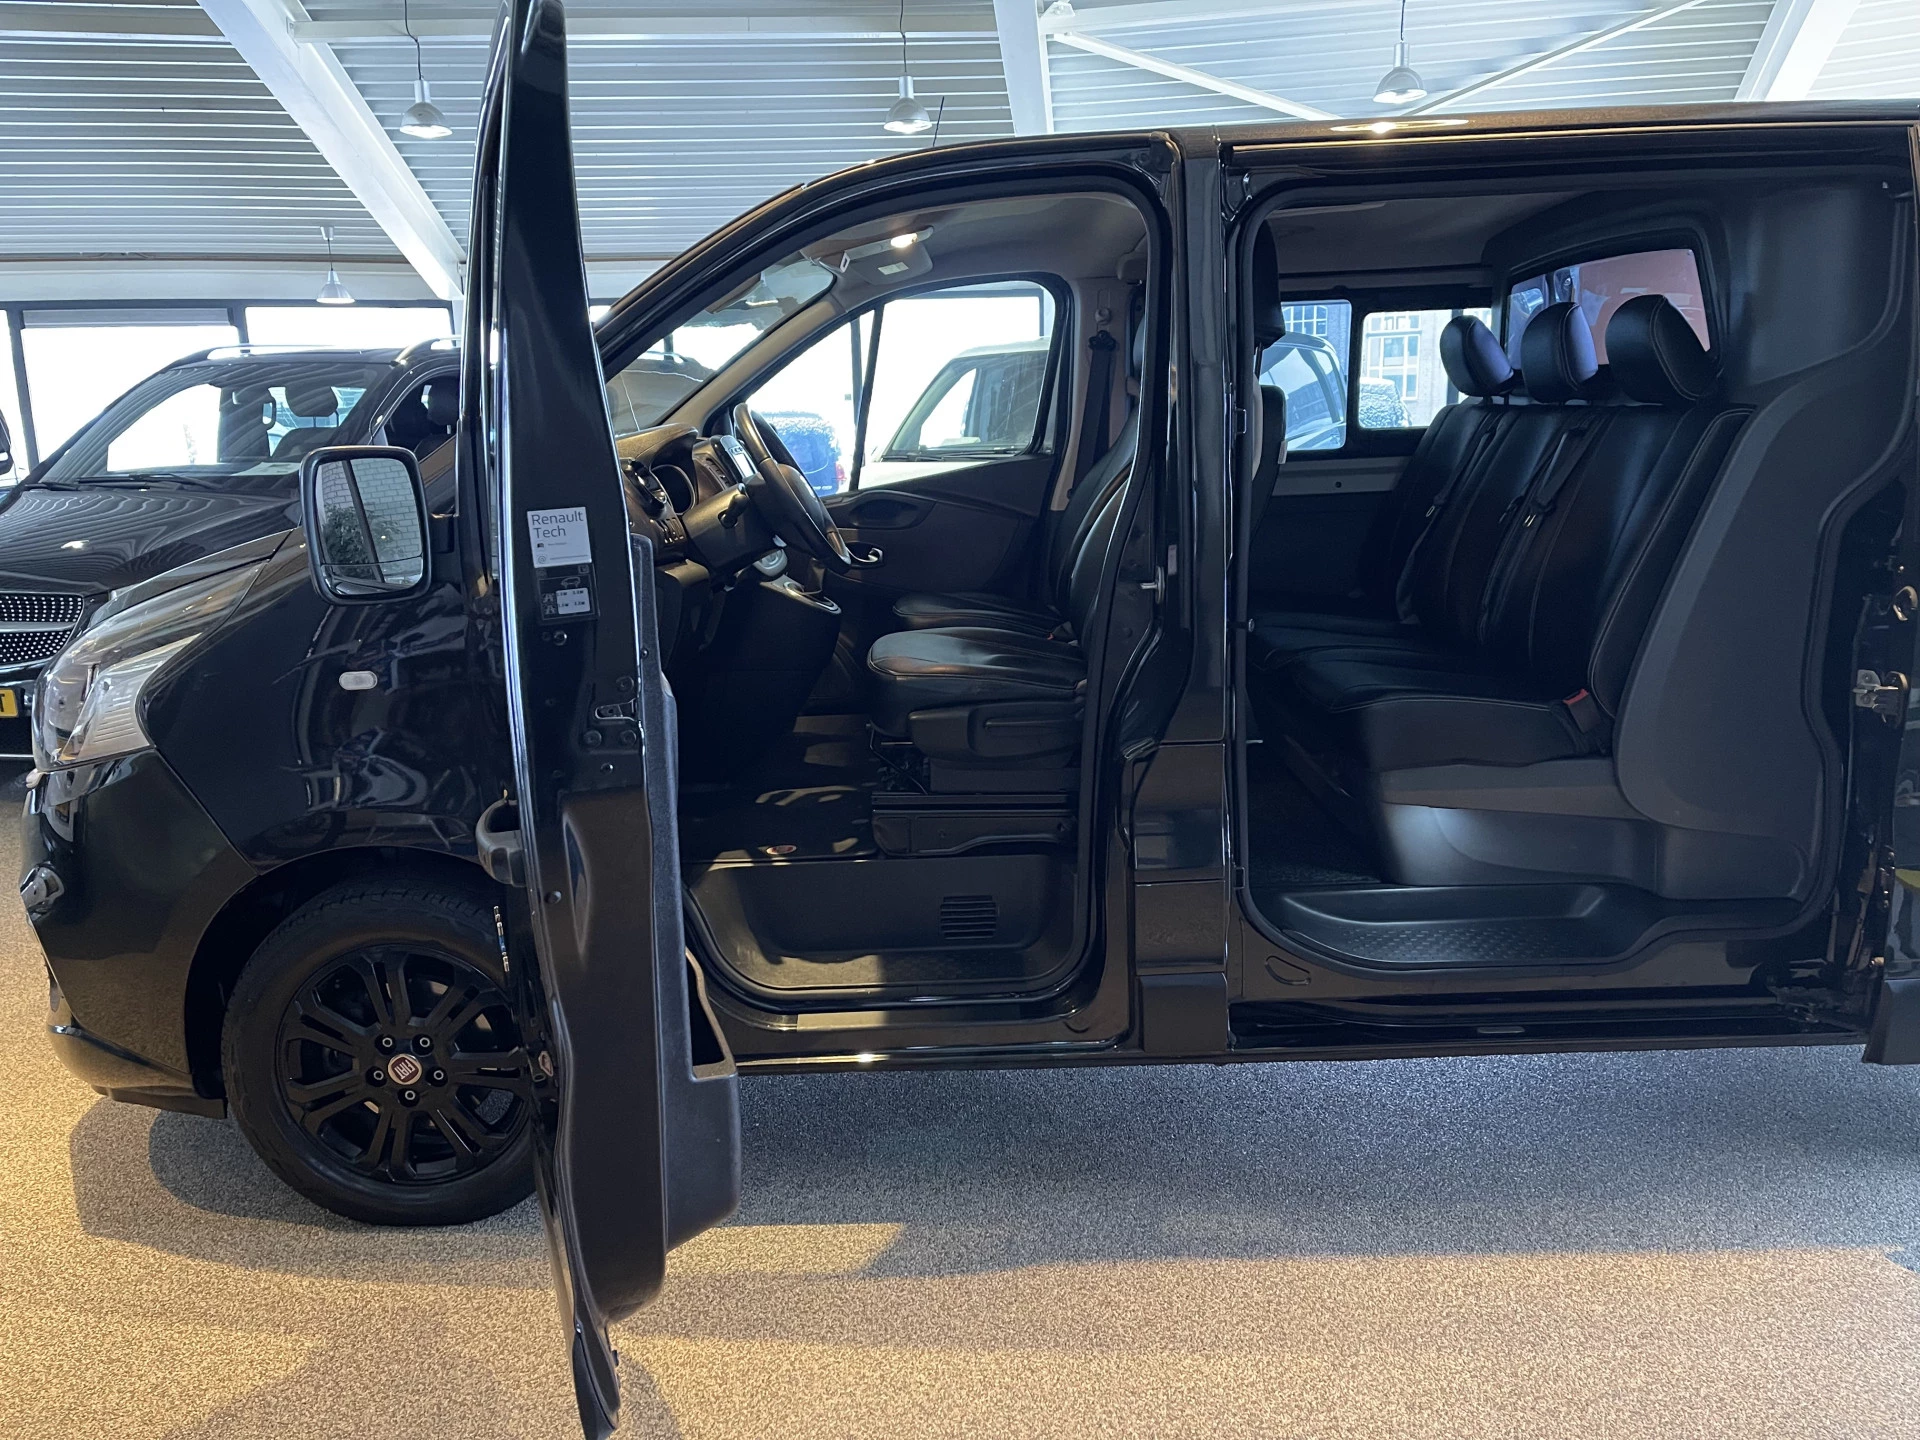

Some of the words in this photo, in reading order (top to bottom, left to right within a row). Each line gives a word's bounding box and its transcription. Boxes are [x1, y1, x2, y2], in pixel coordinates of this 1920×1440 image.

[531, 510, 584, 525] Renault
[533, 525, 566, 538] Tech
[394, 1059, 415, 1079] FIAT
